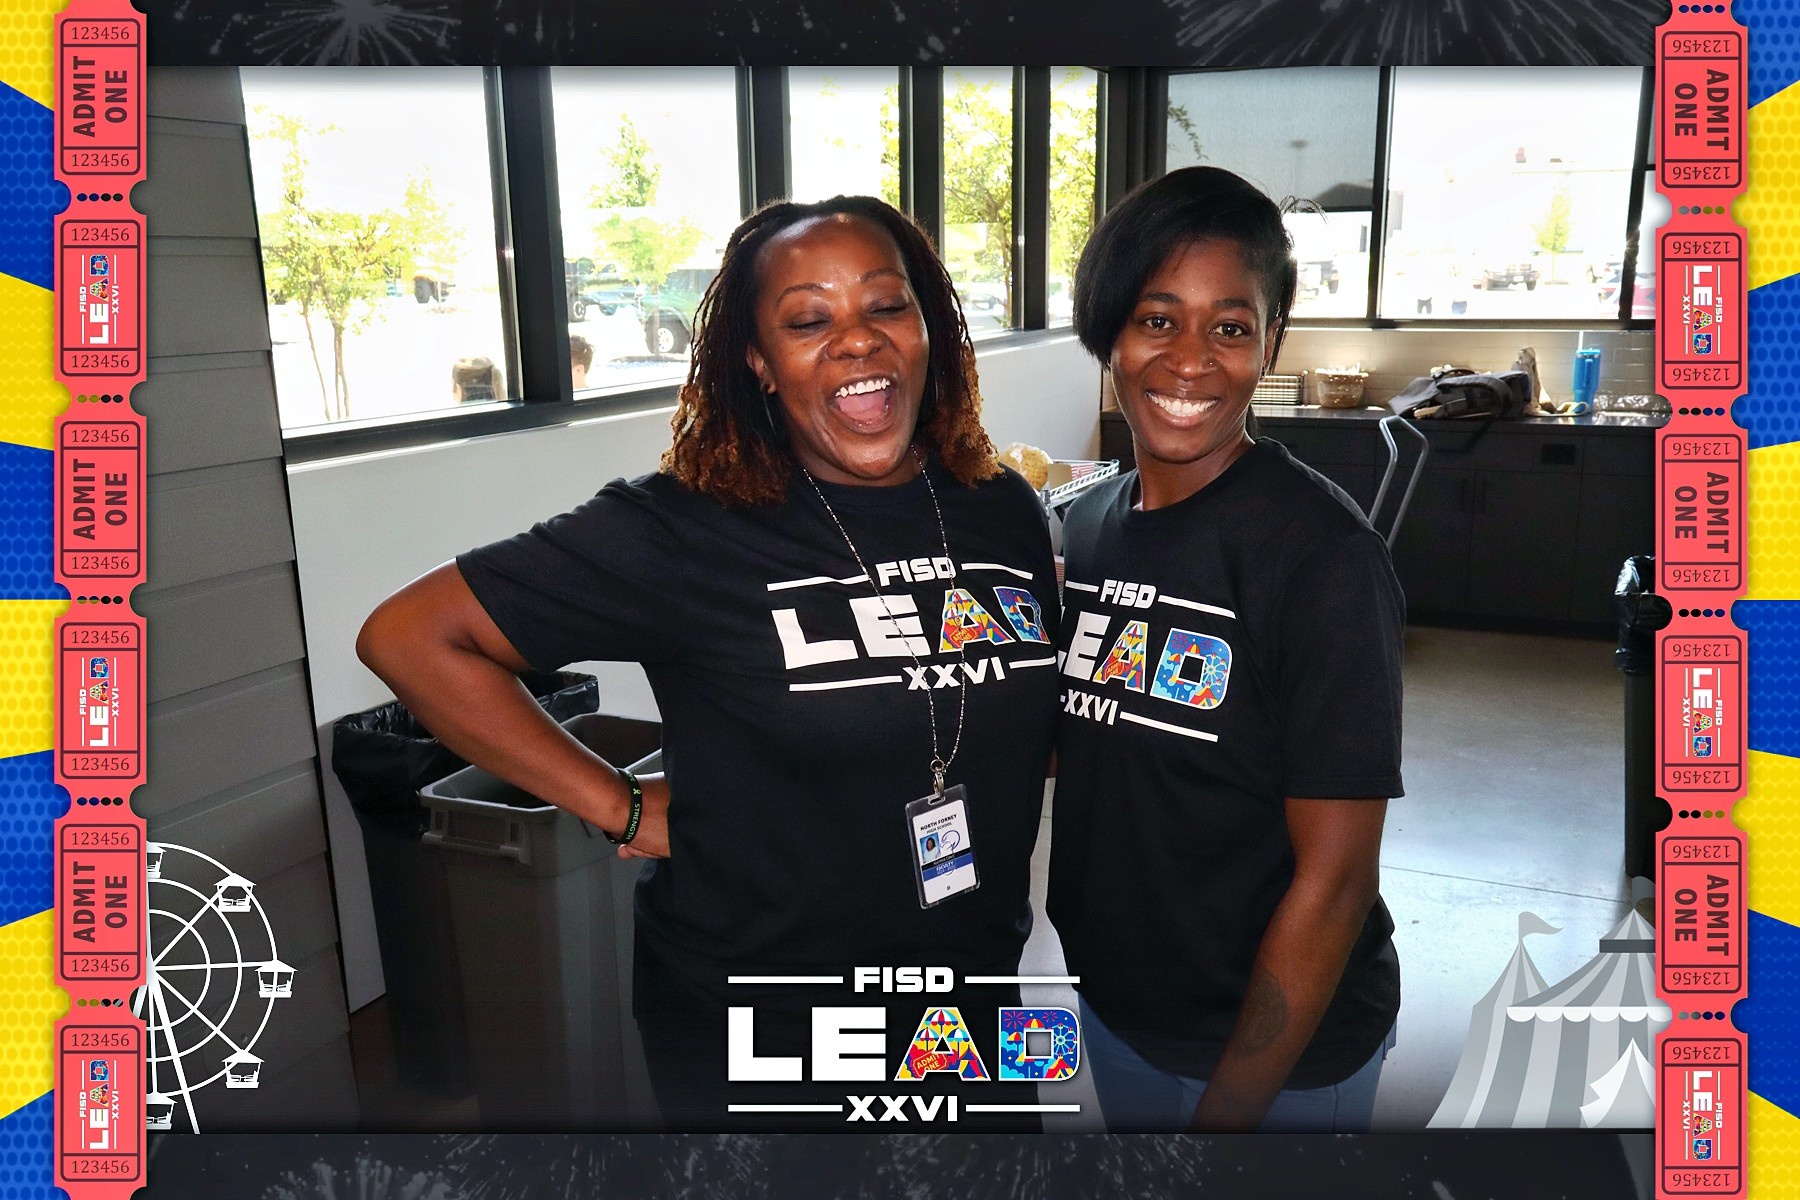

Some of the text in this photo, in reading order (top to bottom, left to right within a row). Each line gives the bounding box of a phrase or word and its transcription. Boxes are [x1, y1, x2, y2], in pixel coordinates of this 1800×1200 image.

[875, 557, 957, 587] FISD
[1099, 579, 1157, 609] FISD
[771, 585, 1051, 670] LEAD
[902, 656, 1006, 691] XXVI
[1058, 605, 1233, 711] EAD
[1063, 689, 1119, 726] XXVI
[626, 803, 641, 840] STRENGTH
[920, 814, 957, 831] NORTH FORNEY
[937, 822, 953, 831] SCHOOL
